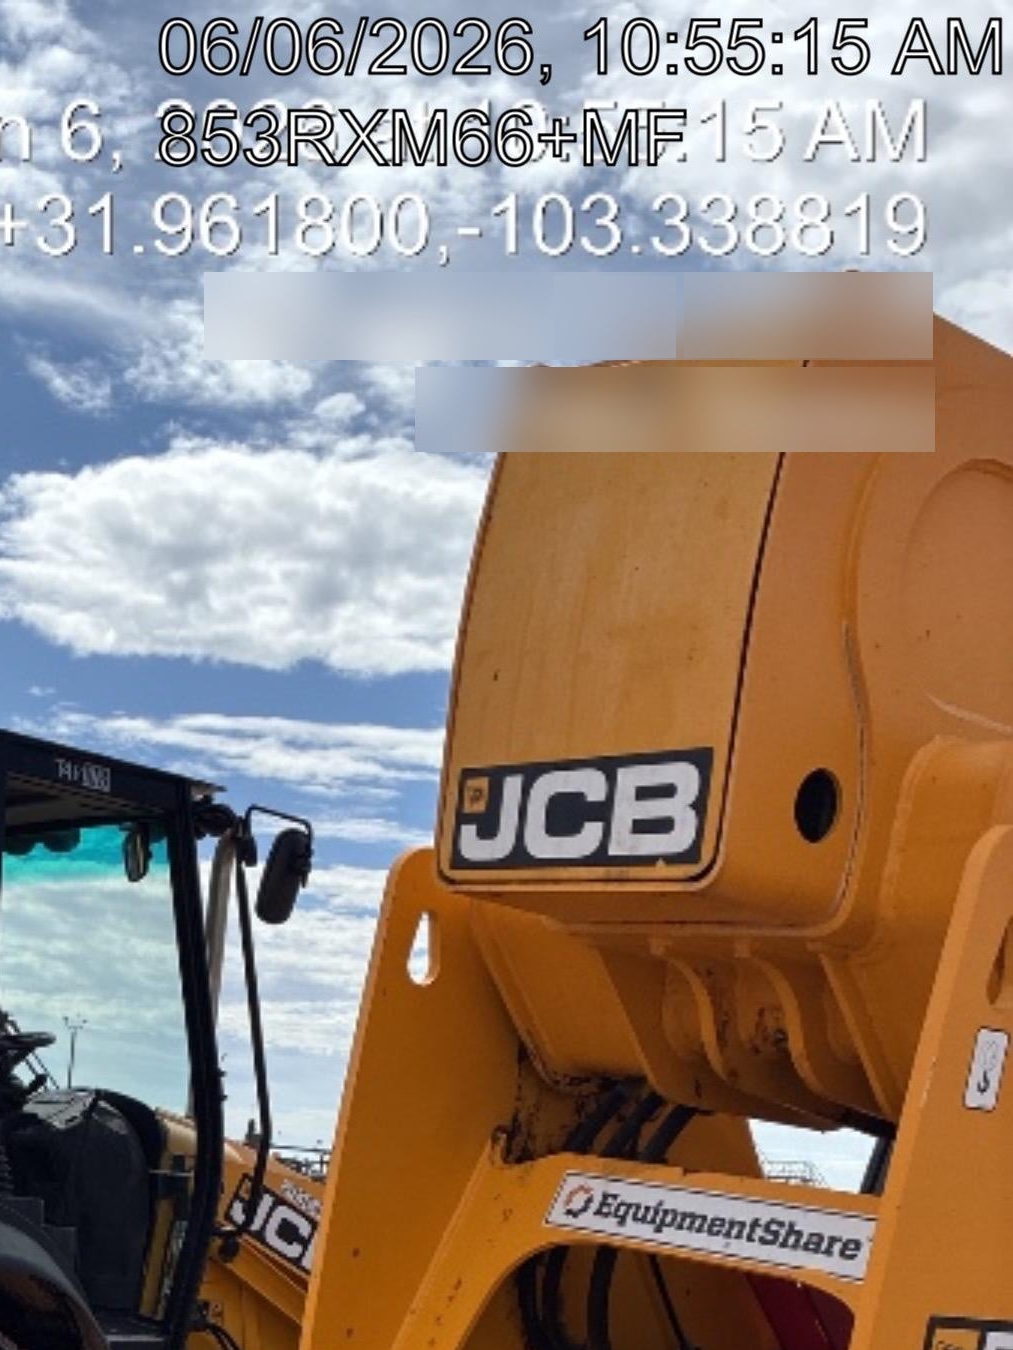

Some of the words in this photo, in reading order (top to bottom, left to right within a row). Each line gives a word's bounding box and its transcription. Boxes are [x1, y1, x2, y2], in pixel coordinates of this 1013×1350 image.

[459, 761, 701, 862] JCB
[229, 1193, 315, 1271] JC
[592, 1191, 864, 1261] EquipmentShare
